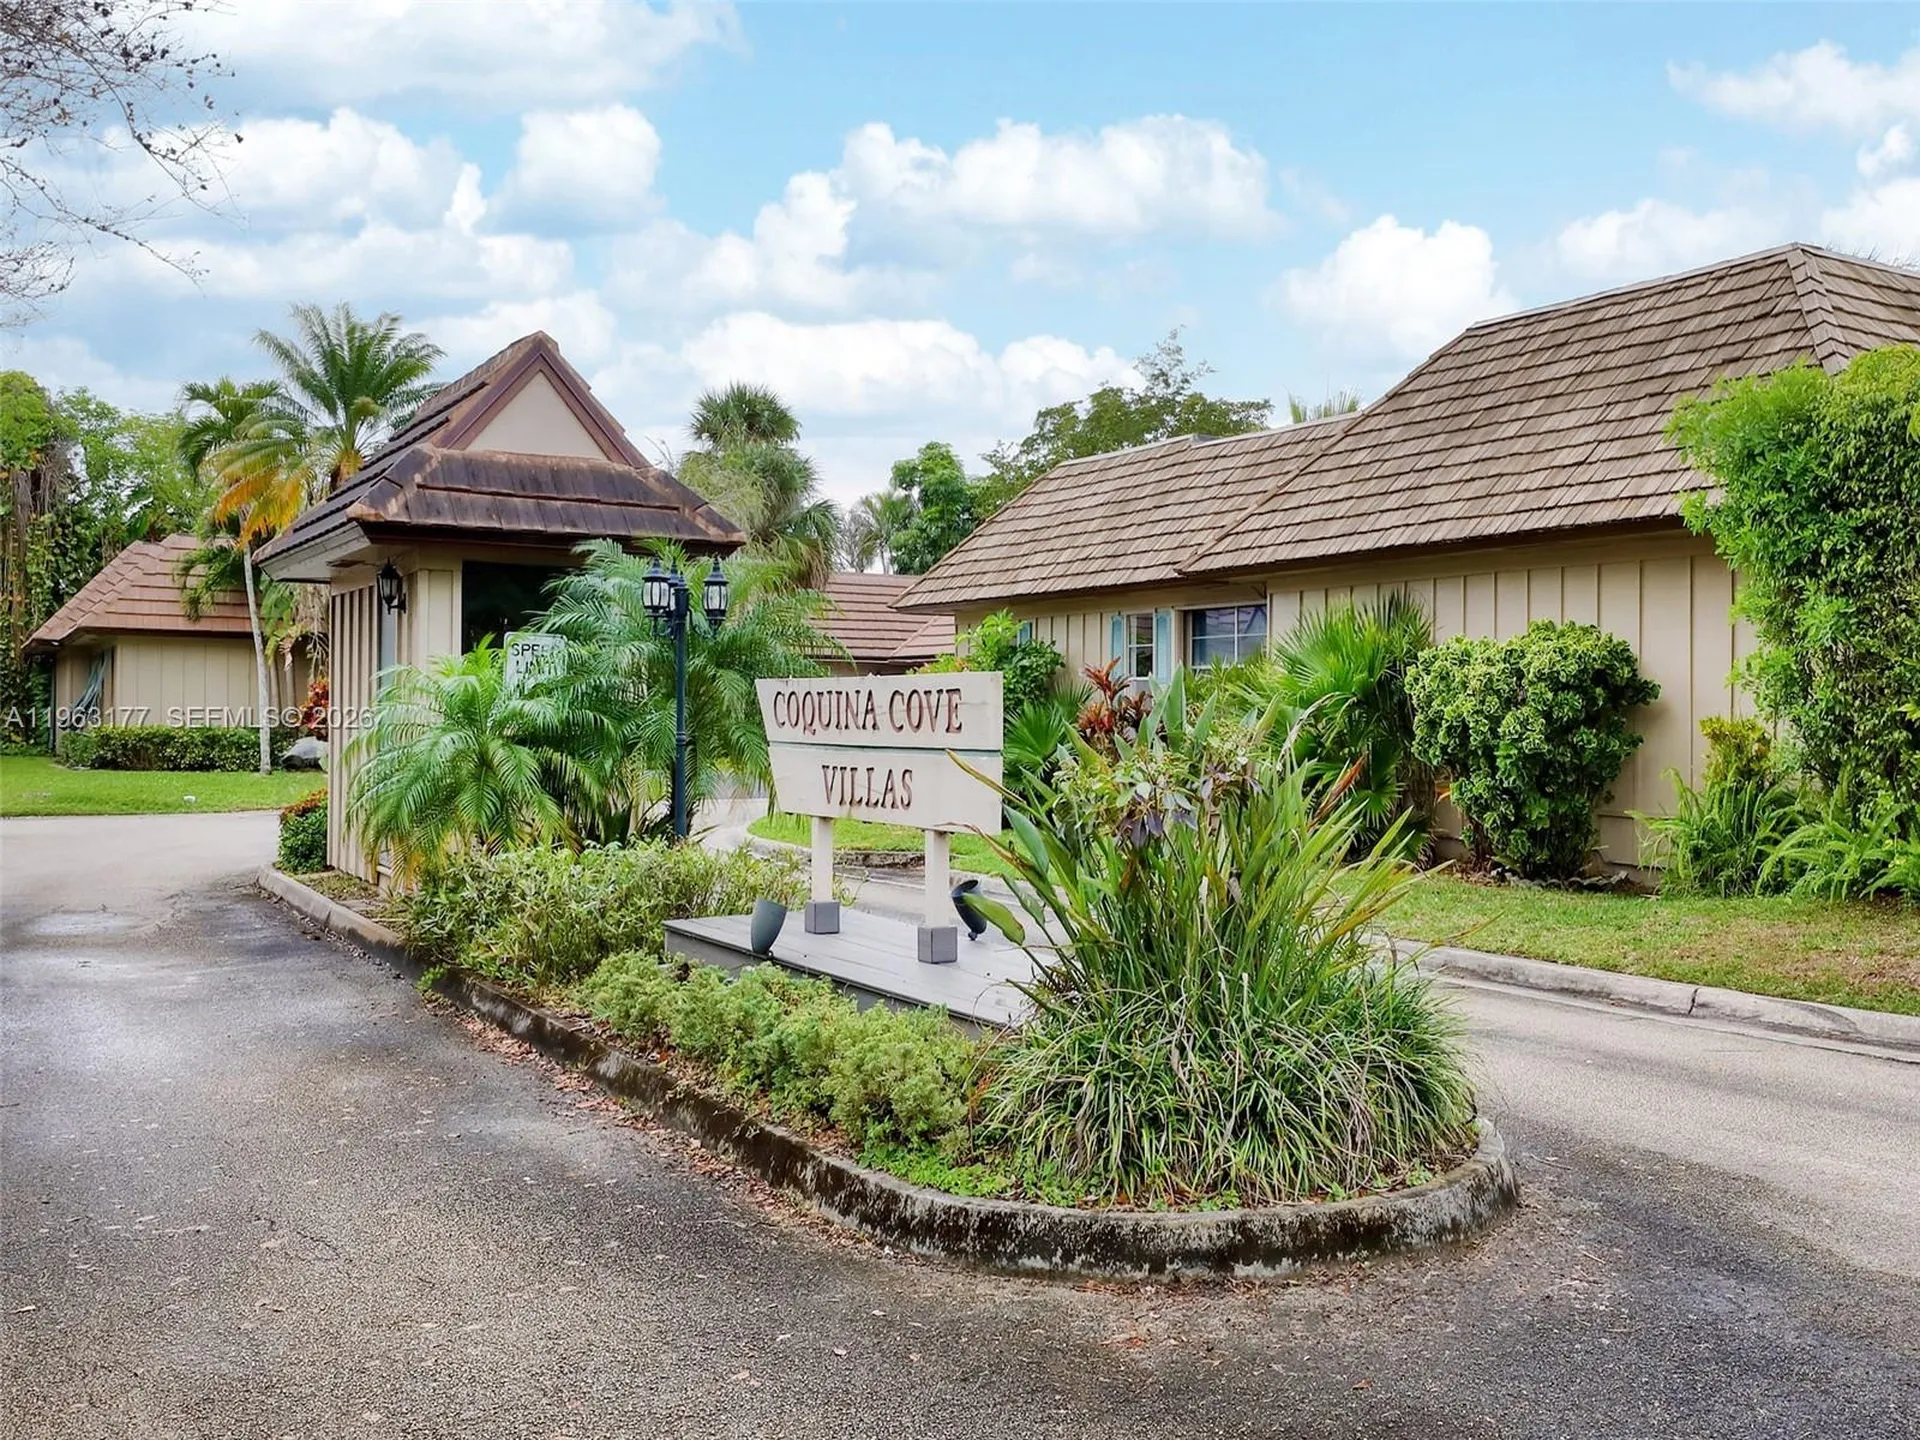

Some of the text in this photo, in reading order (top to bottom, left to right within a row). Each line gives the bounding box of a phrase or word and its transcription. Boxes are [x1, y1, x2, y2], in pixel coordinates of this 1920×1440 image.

[511, 642, 556, 656] SPE
[773, 688, 963, 735] COQUINA COVE
[821, 764, 913, 811] VILLAS
